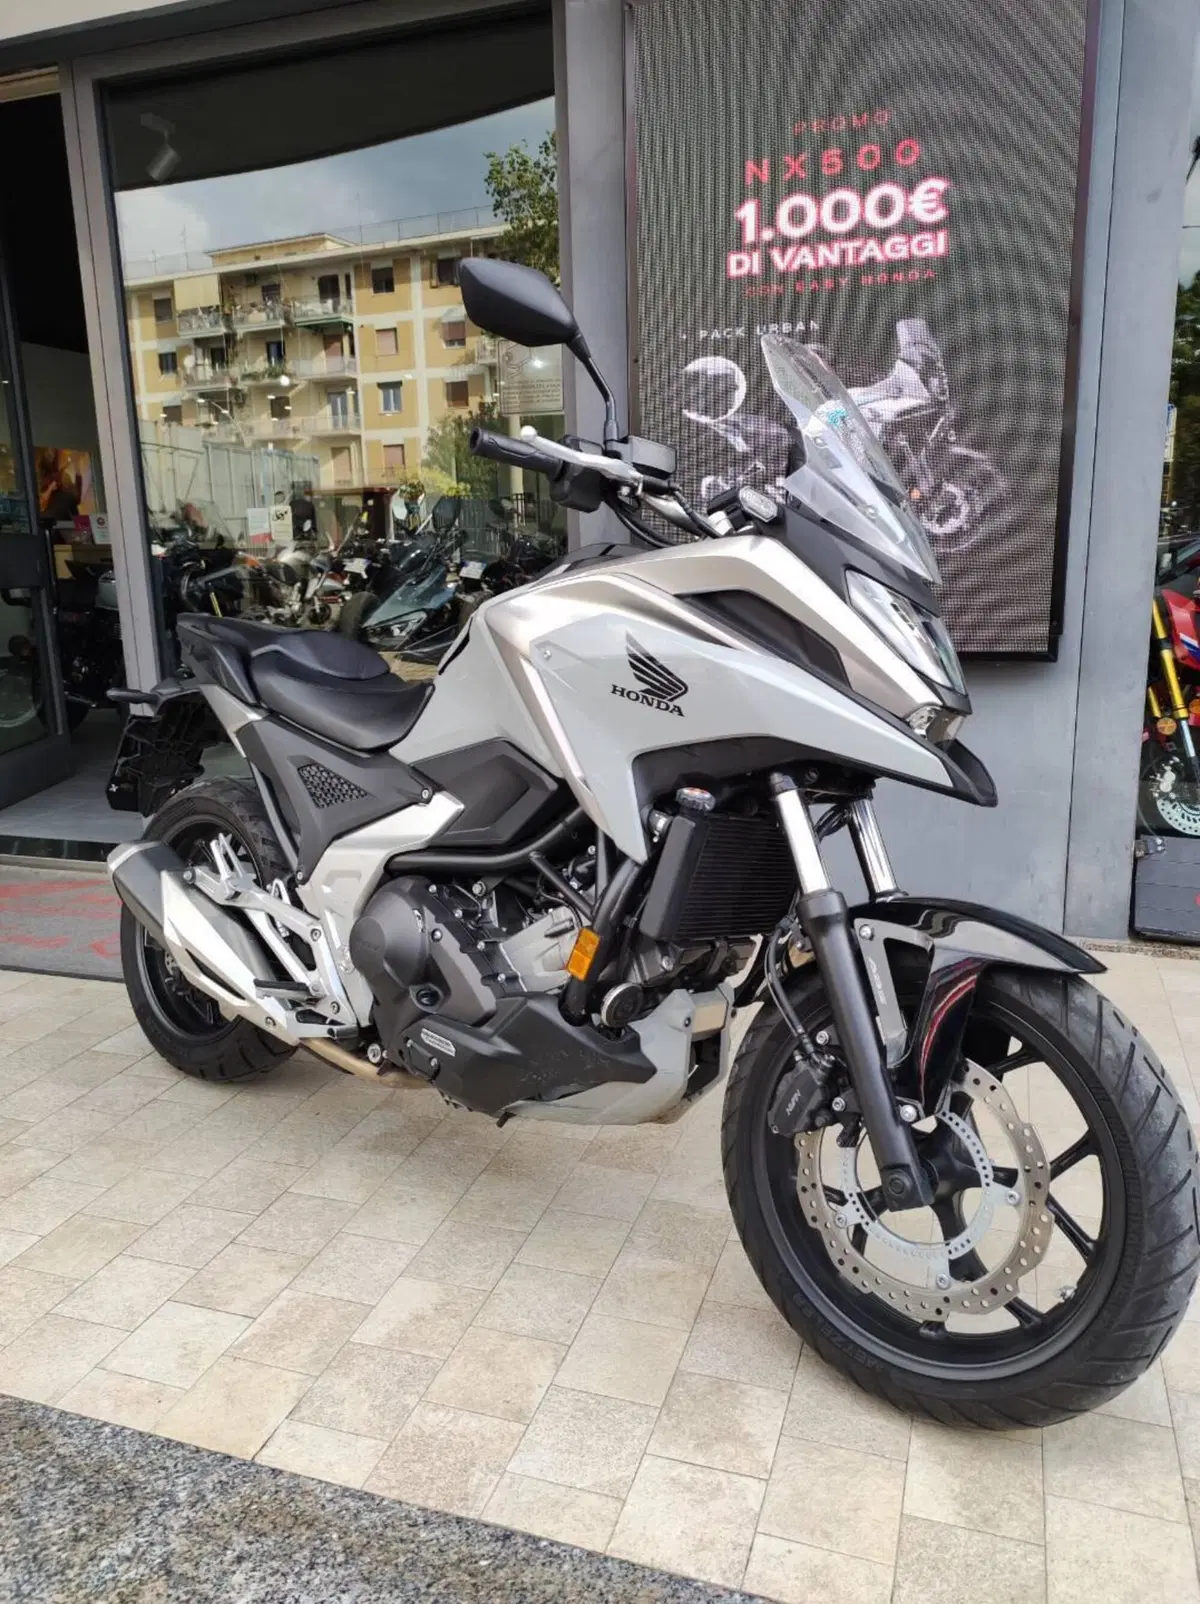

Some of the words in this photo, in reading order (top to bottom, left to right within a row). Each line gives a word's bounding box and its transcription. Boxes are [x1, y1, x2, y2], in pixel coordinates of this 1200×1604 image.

[793, 109, 890, 136] PROMO
[735, 175, 949, 245] 1.000€
[727, 250, 761, 279] DI
[769, 229, 949, 273] VANTAGGI
[699, 325, 745, 341] PACK
[610, 685, 685, 717] HONDA
